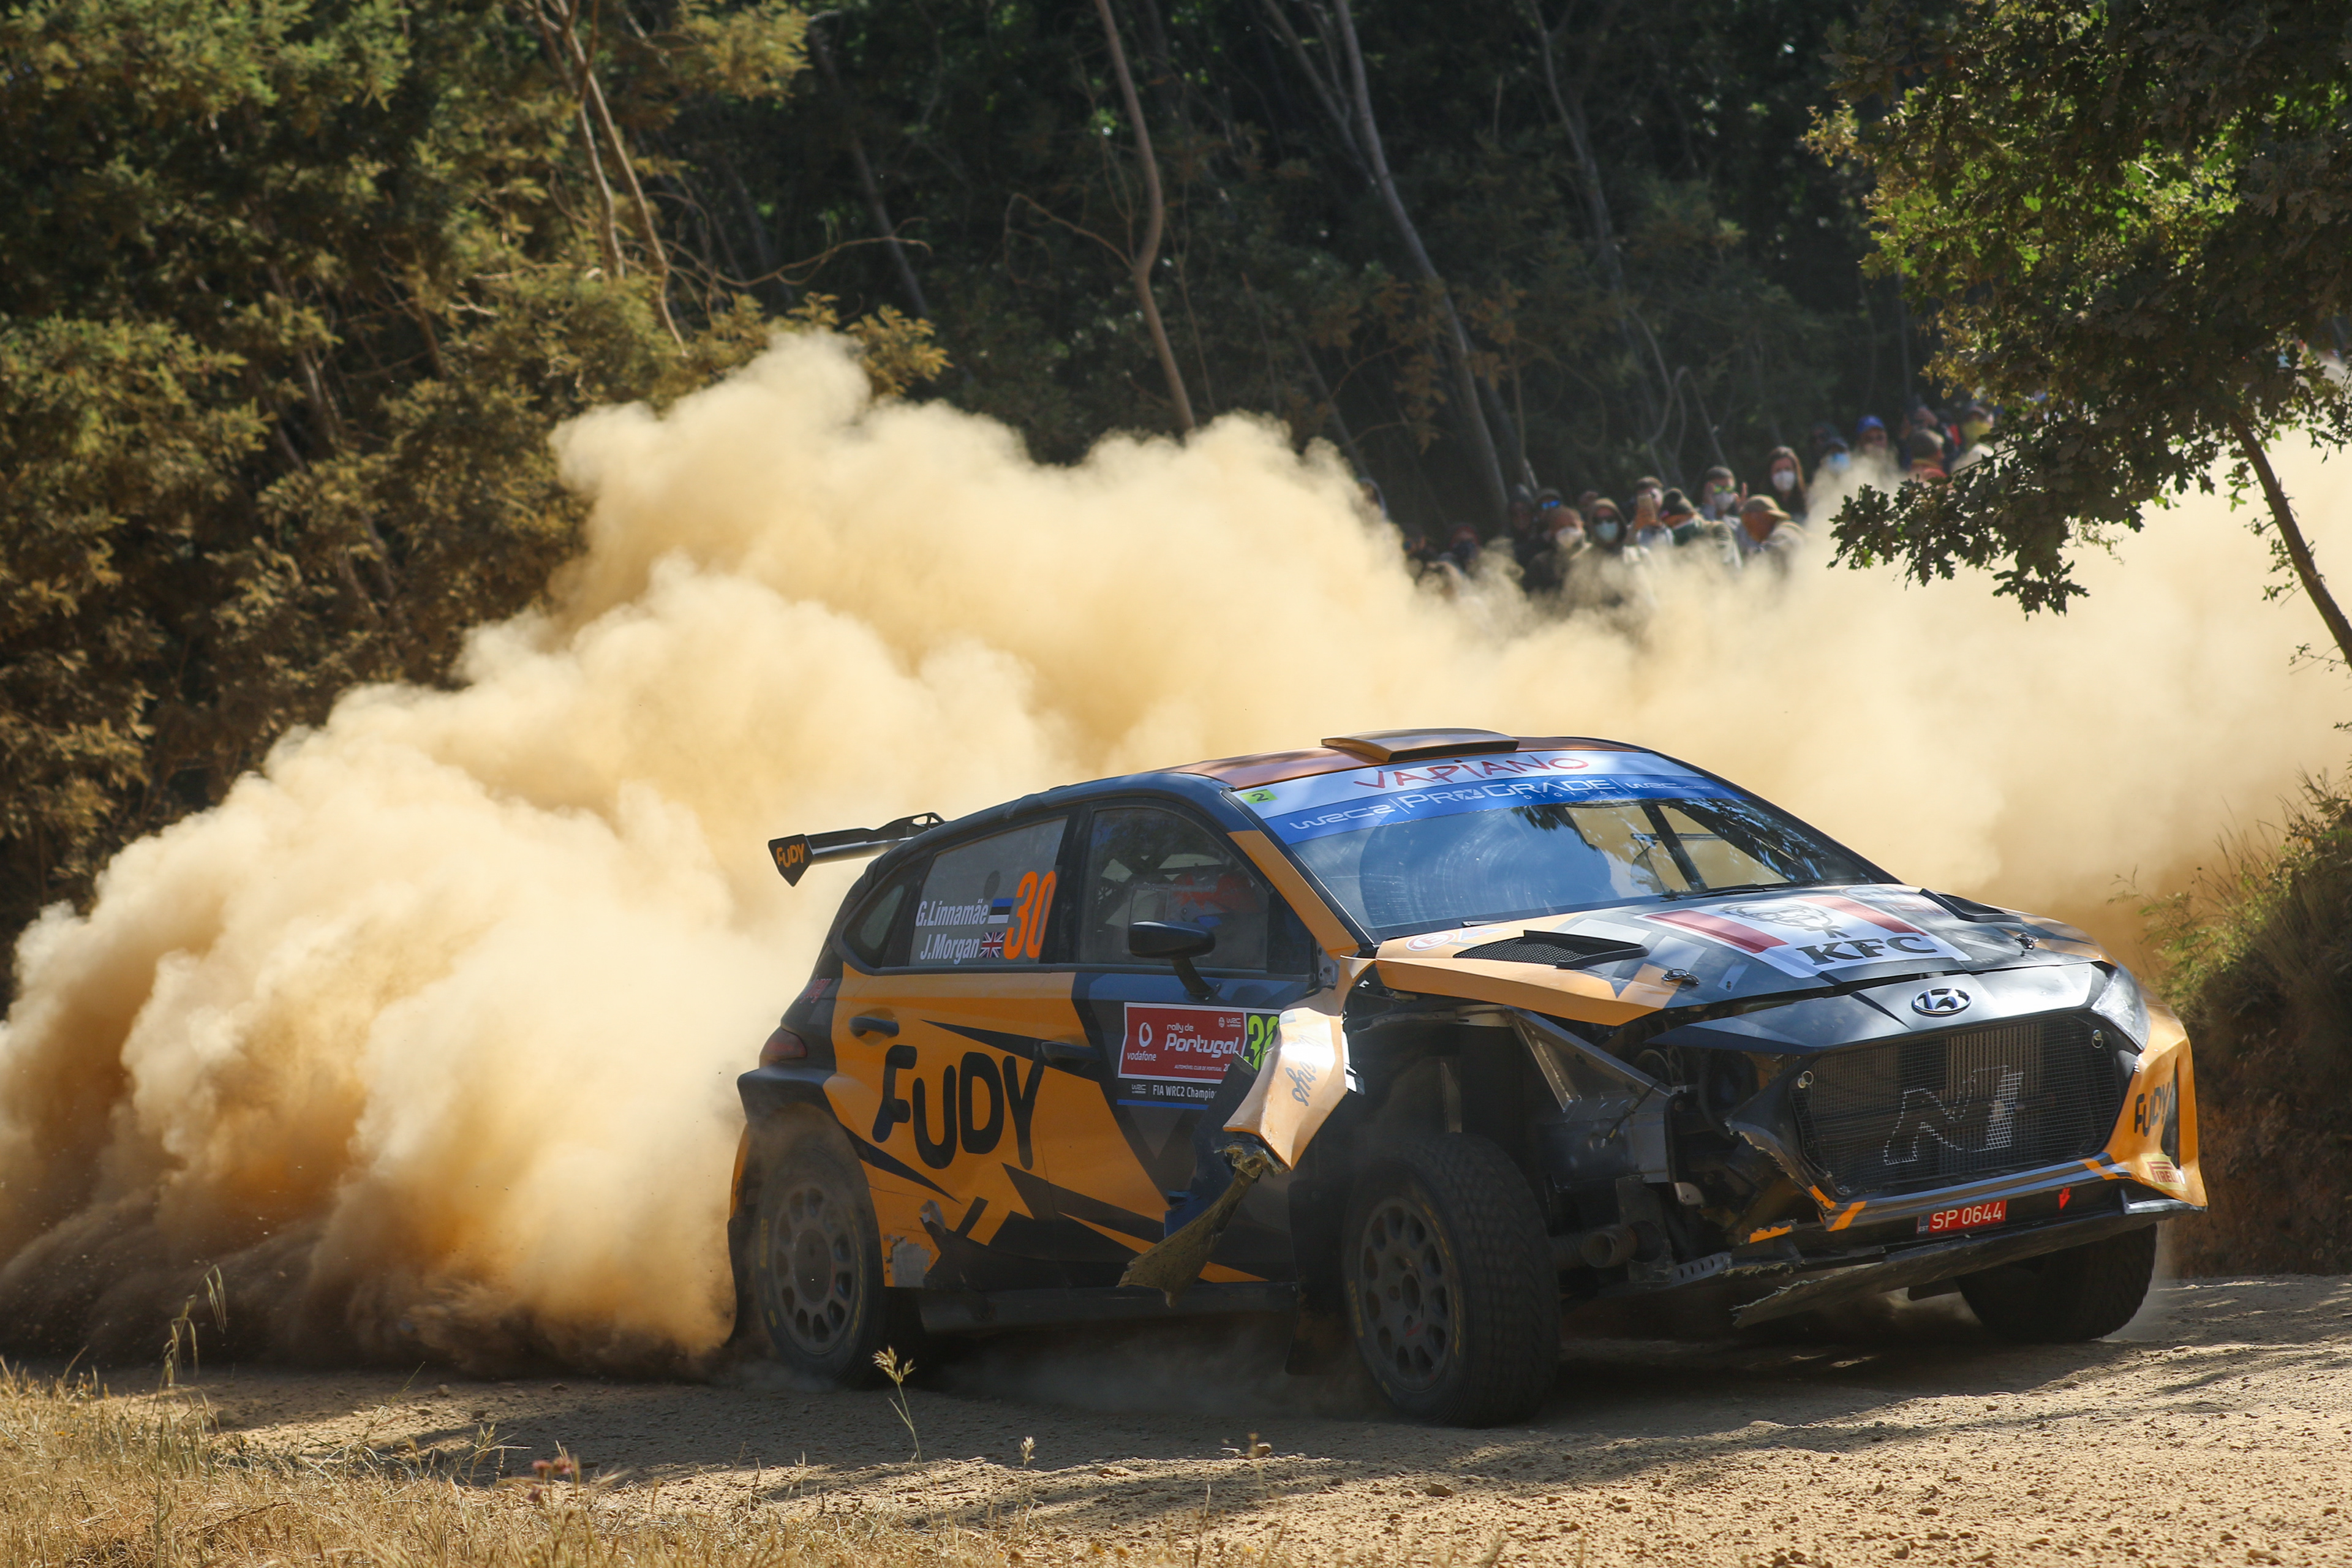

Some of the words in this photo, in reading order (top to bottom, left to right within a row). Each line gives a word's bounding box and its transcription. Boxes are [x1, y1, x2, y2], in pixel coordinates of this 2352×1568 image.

[1354, 753, 1589, 790] VAPIANO
[1251, 793, 1269, 802] 2
[1523, 791, 1623, 800] DIGITAL
[1289, 804, 1396, 829] WRC2
[776, 843, 805, 868] FUDY
[915, 898, 989, 927] G.Linnamäe
[1003, 870, 1057, 960] 30
[920, 933, 980, 965] J.Morgan
[1795, 936, 1937, 966] KFC
[1167, 1023, 1183, 1033] rally
[1127, 1050, 1156, 1061] vodafone
[1164, 1033, 1239, 1058] Portugal
[1153, 1085, 1164, 1096] FIA
[1166, 1086, 1185, 1097] WRC2
[1186, 1087, 1217, 1101] Champio
[872, 1044, 1045, 1171] FUDY
[2134, 1081, 2171, 1137] FUDY
[1932, 1209, 1958, 1229] SP
[1962, 1202, 2002, 1225] 0644
